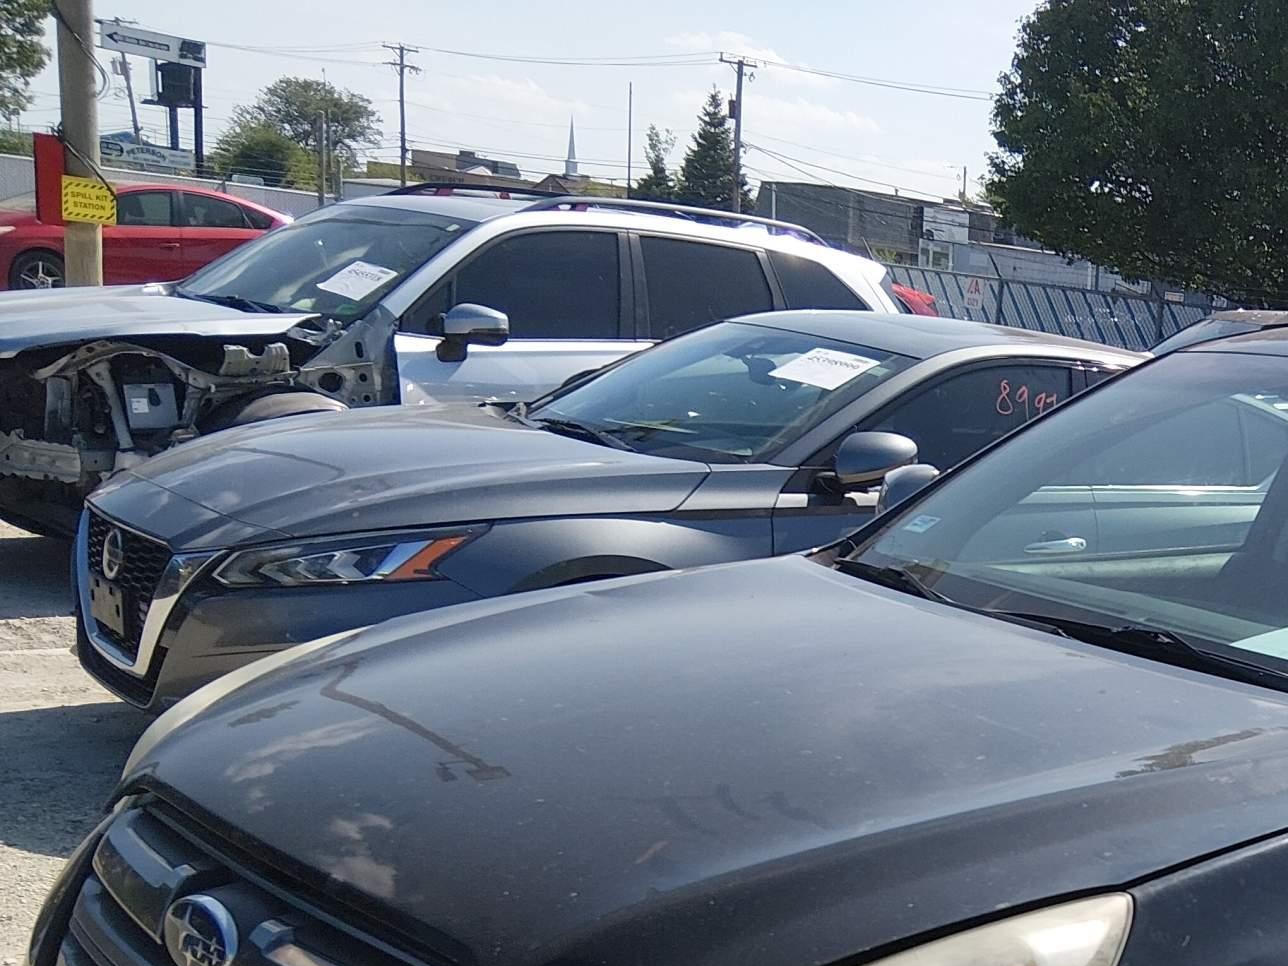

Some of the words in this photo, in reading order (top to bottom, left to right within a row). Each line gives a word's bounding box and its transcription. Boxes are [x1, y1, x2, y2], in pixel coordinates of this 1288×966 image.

[71, 191, 93, 201] SPILL
[95, 194, 108, 202] KIT
[73, 200, 106, 211] STATION
